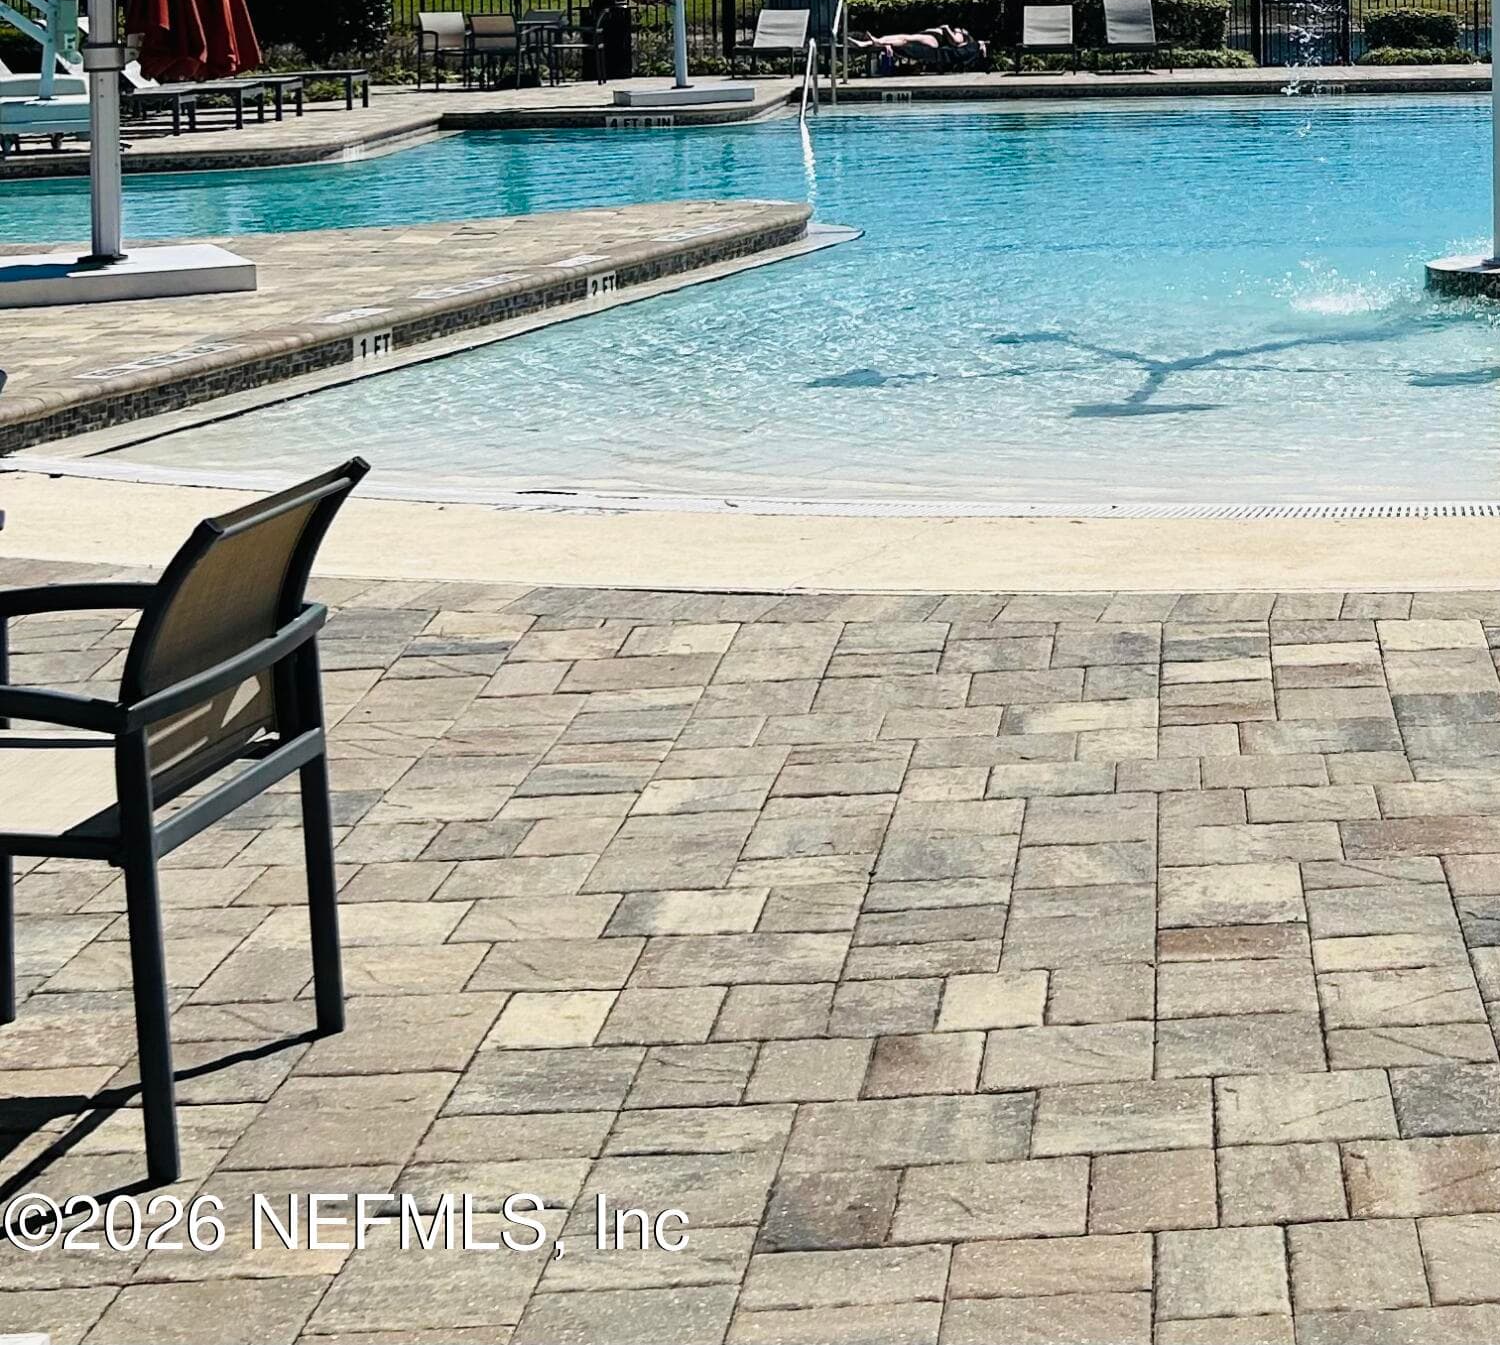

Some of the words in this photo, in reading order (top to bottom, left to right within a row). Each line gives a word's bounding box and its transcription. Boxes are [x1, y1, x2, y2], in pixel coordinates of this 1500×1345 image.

[602, 276, 615, 293] FT
[360, 338, 367, 358] 1
[374, 333, 391, 355] FT
